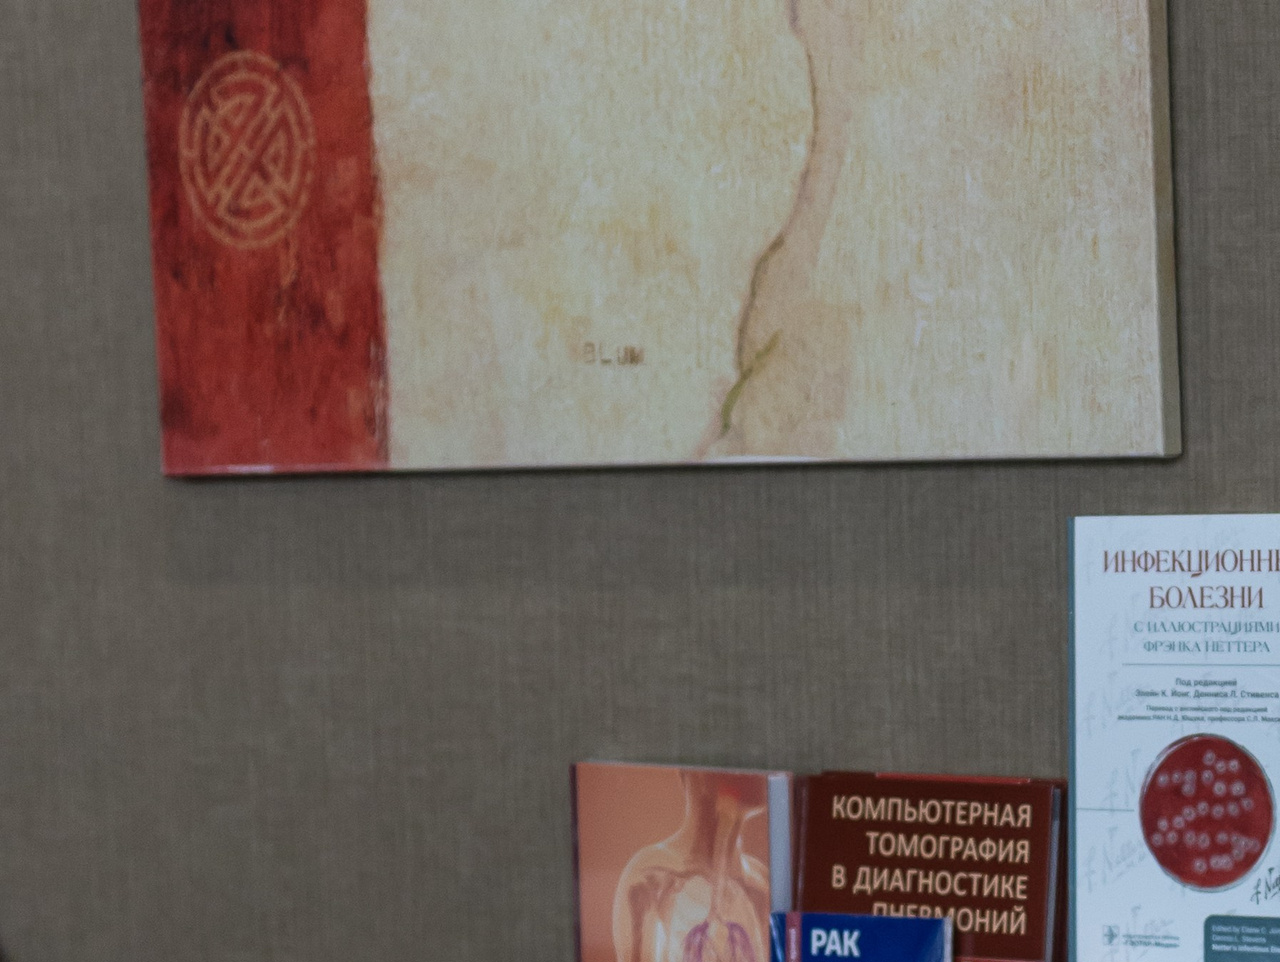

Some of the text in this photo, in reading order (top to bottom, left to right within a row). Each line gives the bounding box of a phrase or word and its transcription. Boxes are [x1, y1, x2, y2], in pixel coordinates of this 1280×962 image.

[1149, 586, 1264, 609] БОЛЕЗНИ
[1133, 621, 1280, 636] С ИЛЛЮСТРАЦИЯМИ
[1143, 641, 1271, 653] ФРЭНКА НЕТТЕРА
[1175, 678, 1238, 688] Под редакцией
[1193, 690, 1229, 699] Денниса
[1240, 690, 1279, 699] Стивенса
[832, 795, 1032, 828] КОМПЬЮТЕРНАЯ
[866, 831, 1031, 864] ТОМОГРАФИЯ
[831, 864, 1029, 900] В ДИАГНОСТИКЕ
[810, 927, 861, 957] РАК
